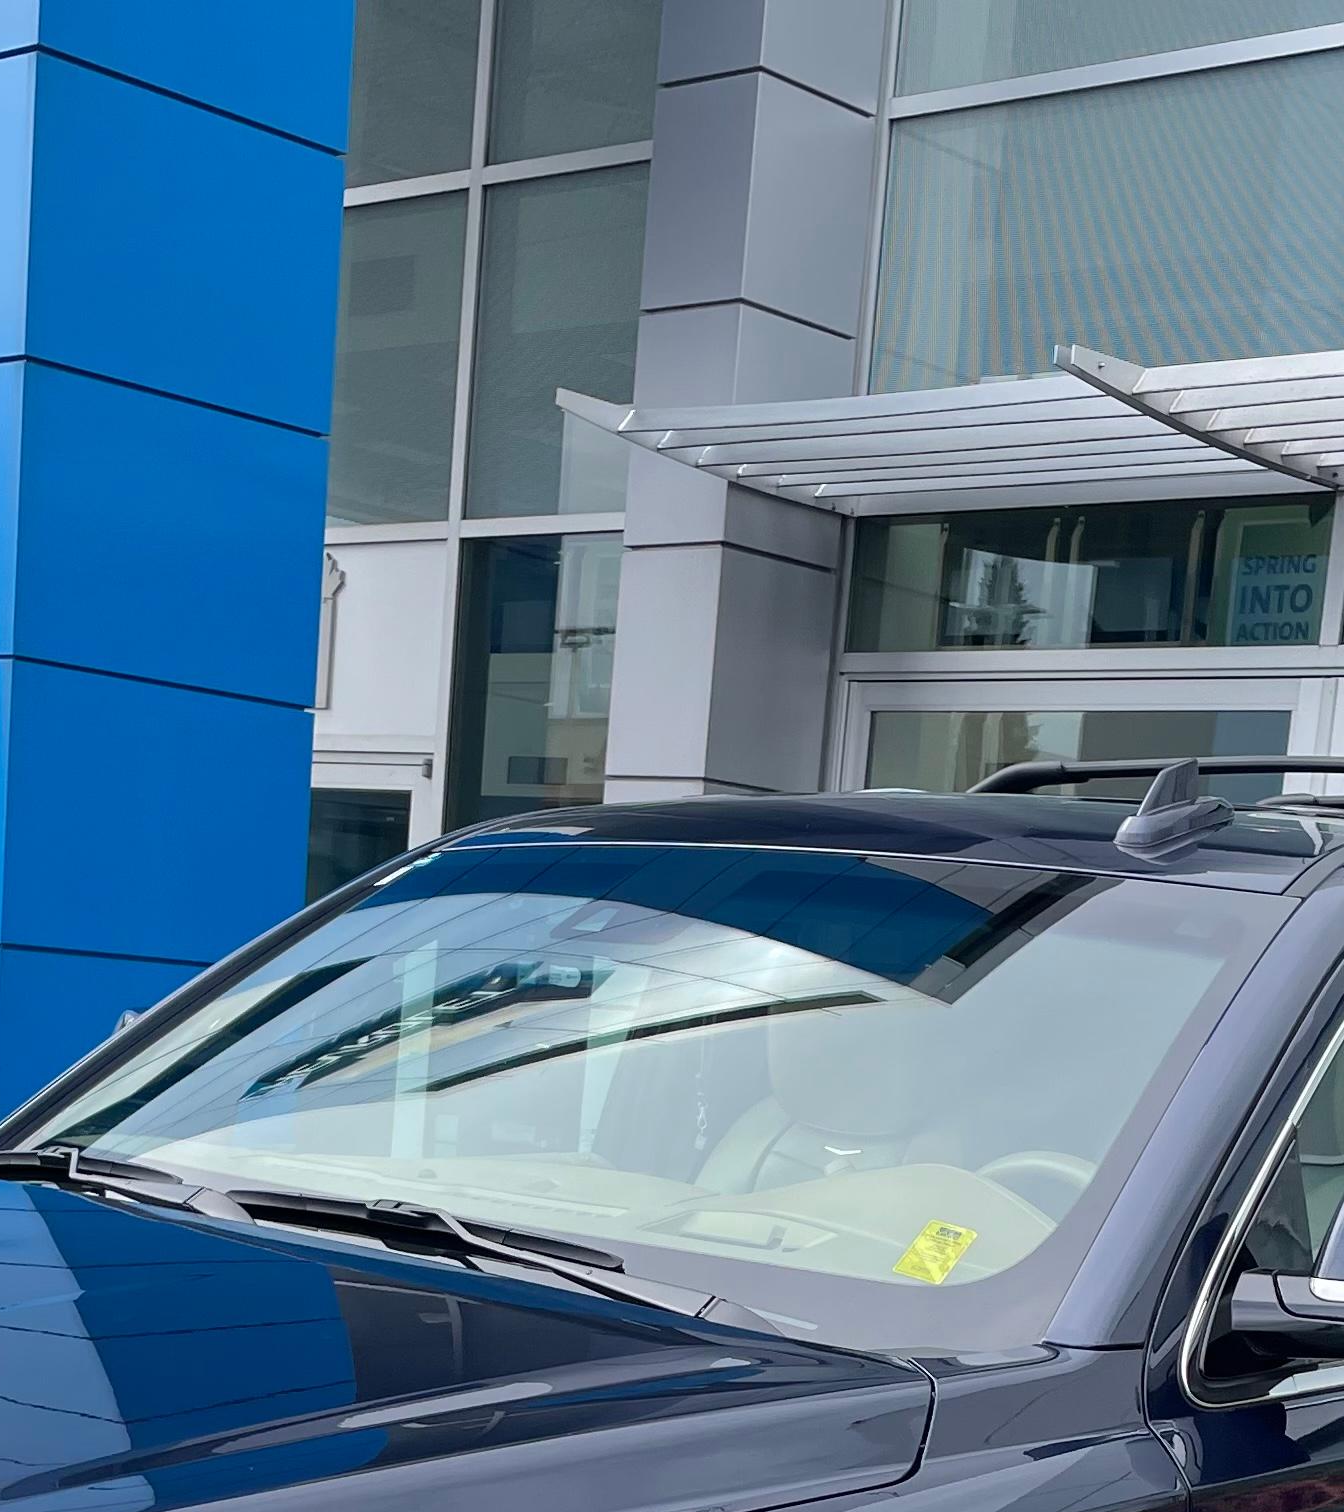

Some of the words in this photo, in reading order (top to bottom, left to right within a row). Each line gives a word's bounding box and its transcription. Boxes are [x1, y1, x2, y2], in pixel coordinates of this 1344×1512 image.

[1241, 553, 1318, 576] SPRING
[1239, 583, 1314, 615] INTO
[1235, 620, 1310, 642] ACTION
